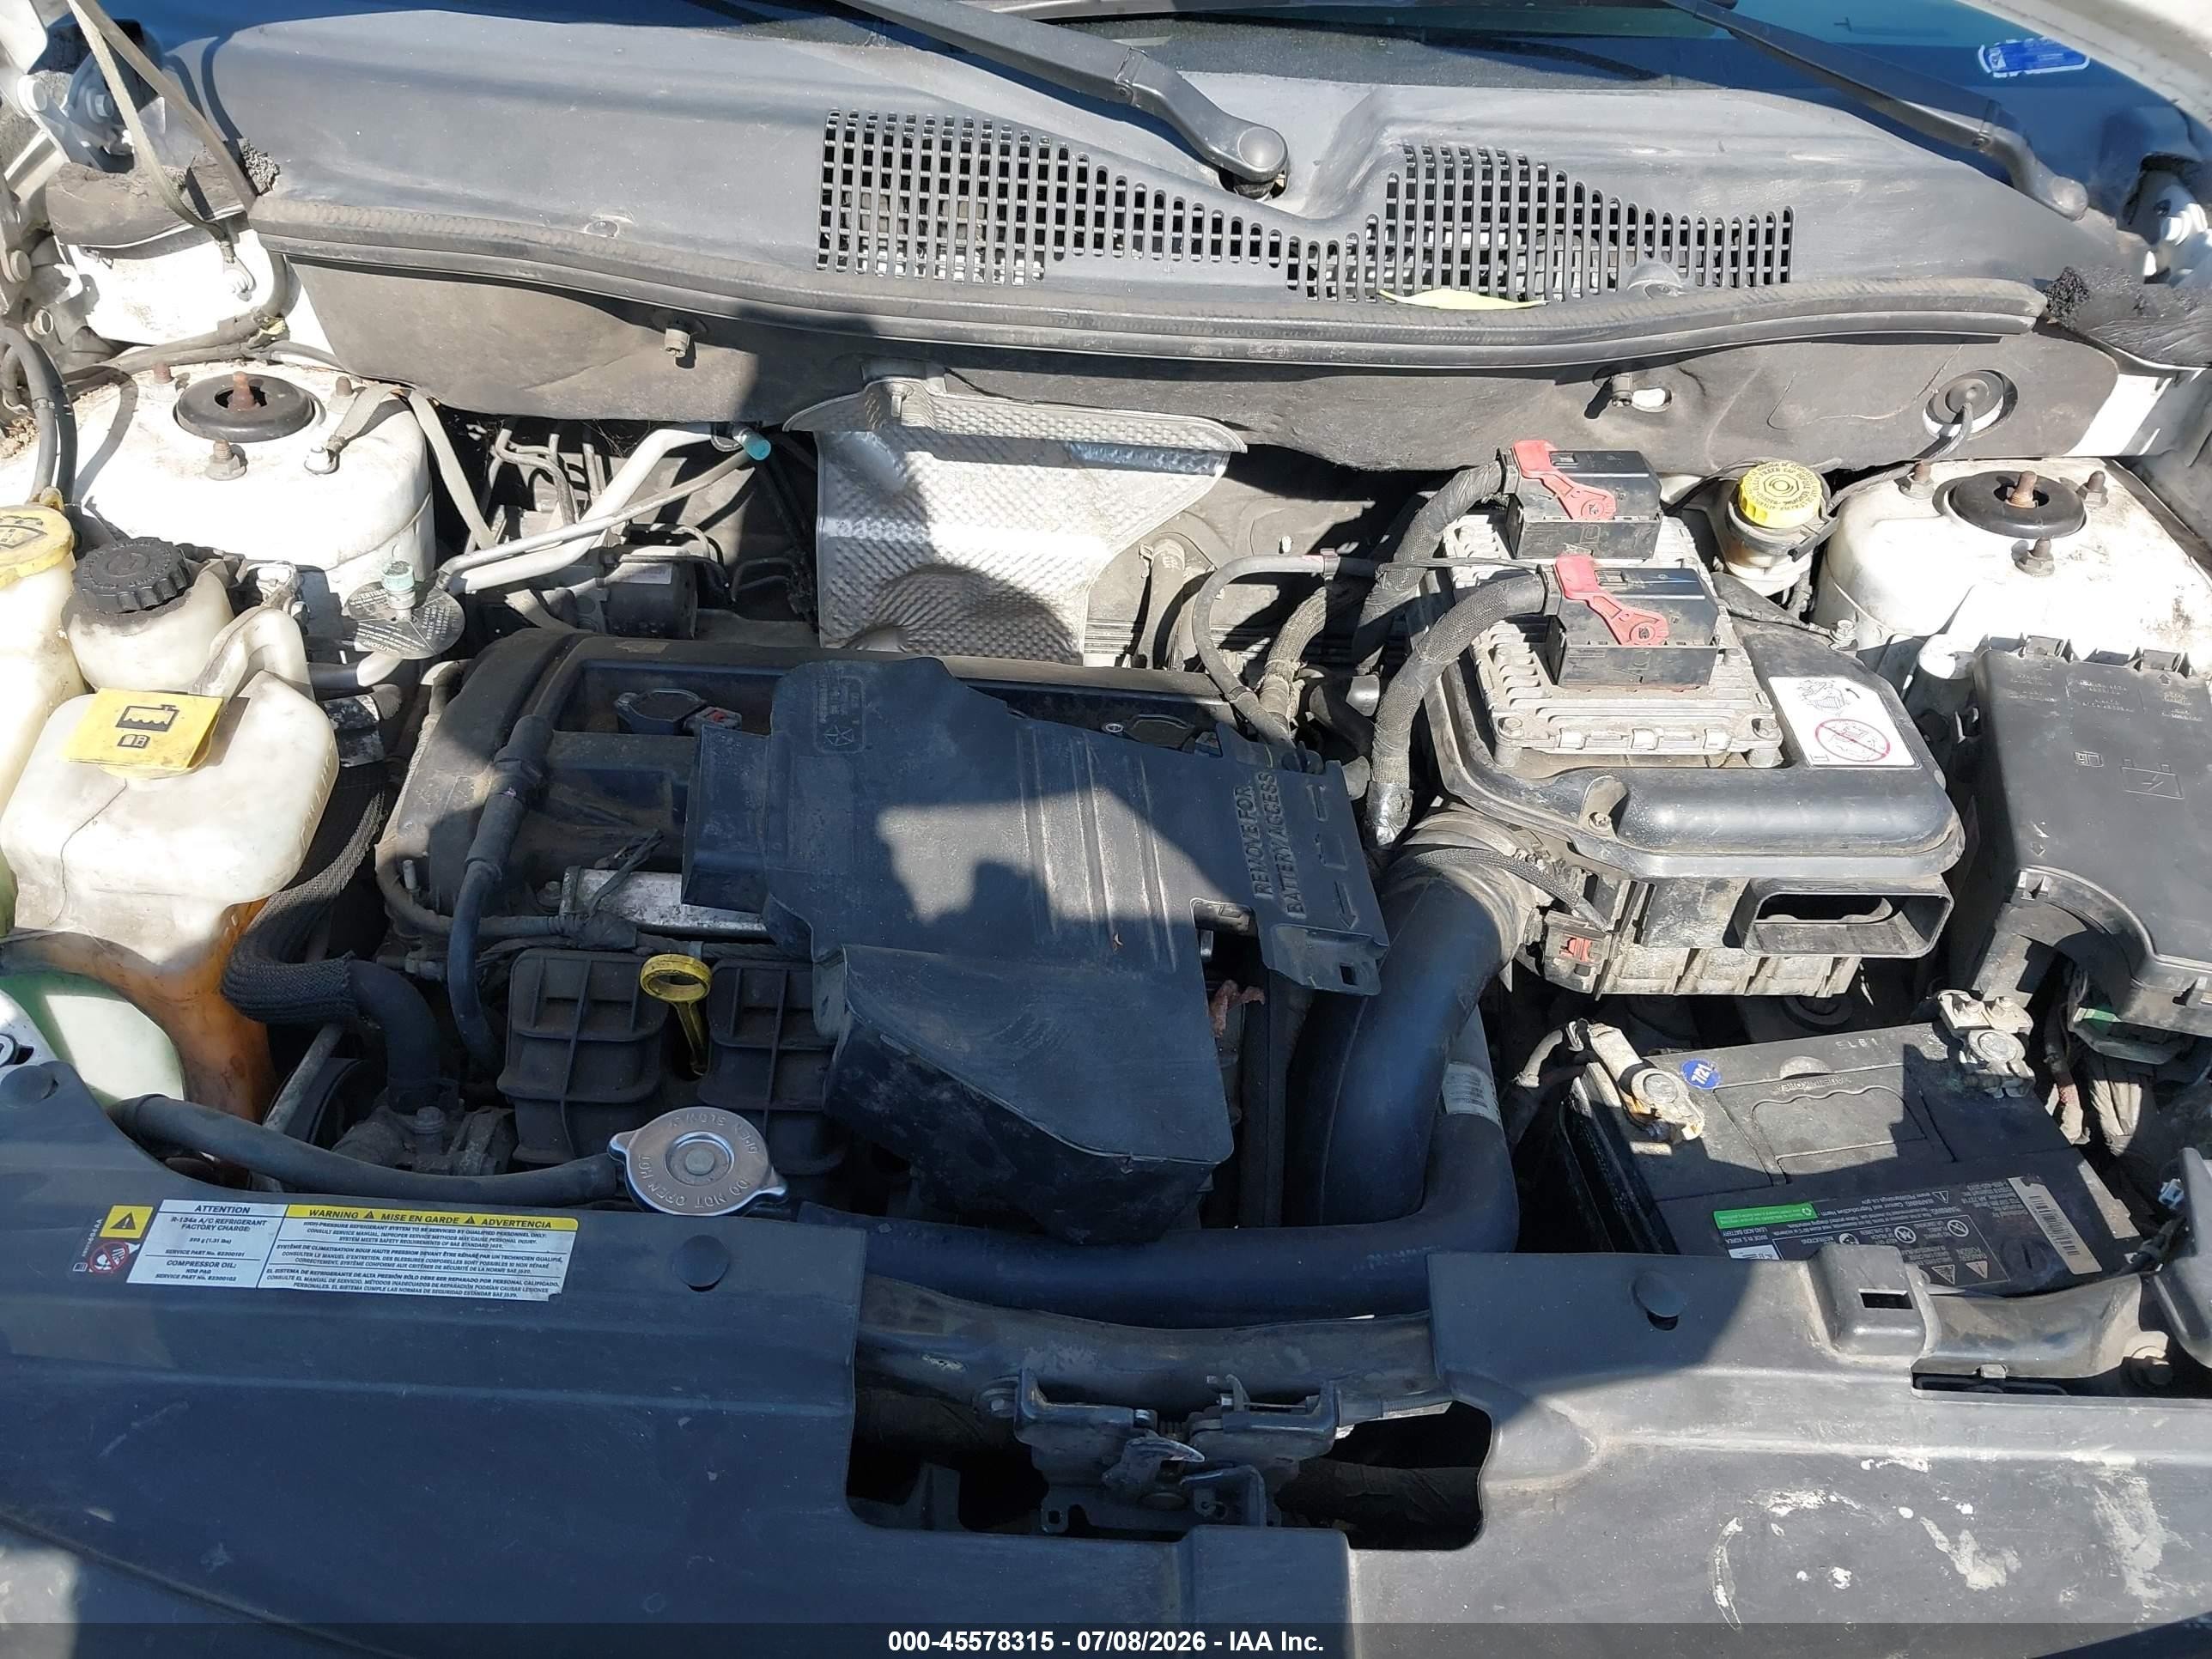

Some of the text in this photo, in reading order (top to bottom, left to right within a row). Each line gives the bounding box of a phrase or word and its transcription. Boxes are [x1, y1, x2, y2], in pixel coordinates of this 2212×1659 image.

[1235, 786, 1273, 899] REMOVE FOR
[1259, 774, 1306, 916] BATTERY ACCESS
[647, 1182, 686, 1206] OPEN
[729, 1178, 751, 1196] DO
[194, 1205, 251, 1213] ATTENTION
[695, 1193, 727, 1209] NOT
[307, 1209, 359, 1218] WARNING
[380, 1212, 407, 1221] MISE
[424, 1215, 459, 1224] GARDE
[480, 1218, 552, 1228] ADVERTENCIA
